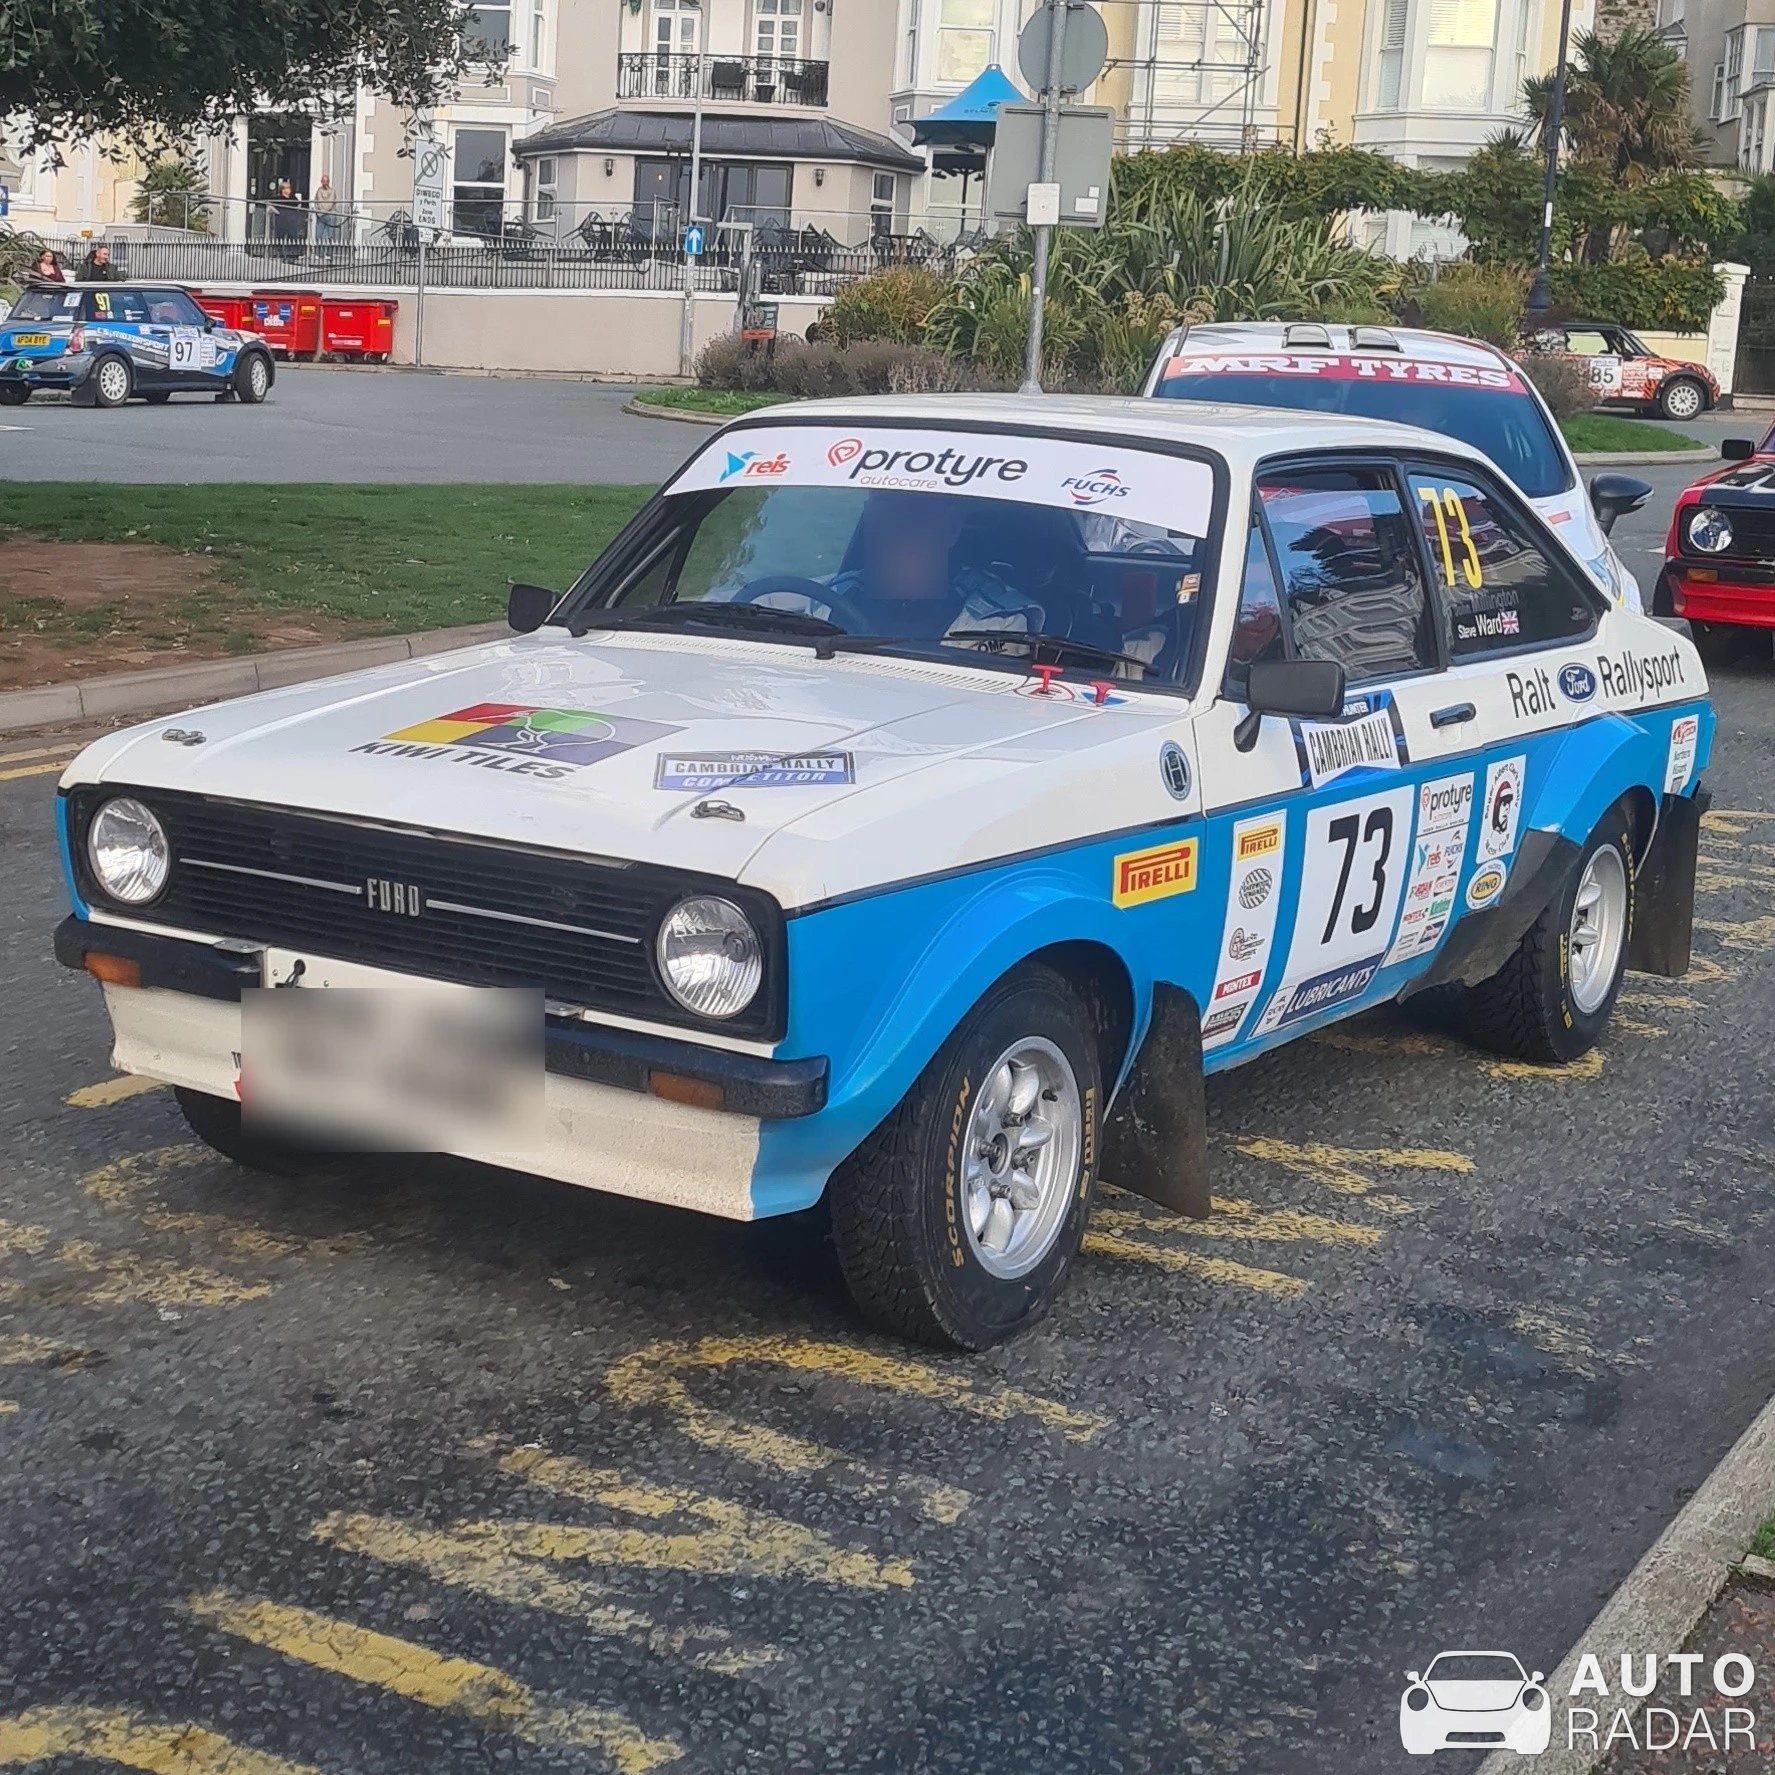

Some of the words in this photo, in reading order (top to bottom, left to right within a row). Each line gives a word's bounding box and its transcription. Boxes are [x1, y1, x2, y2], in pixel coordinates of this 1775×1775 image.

[95, 292, 111, 311] 97
[175, 341, 194, 362] 97
[1180, 356, 1340, 374] MRF
[1350, 358, 1511, 388] TYRES
[1591, 366, 1614, 384] 85
[746, 453, 791, 474] reis
[849, 446, 1028, 486] protyre
[859, 475, 938, 490] autocare
[1061, 477, 1132, 499] FUCHS
[1418, 487, 1484, 589] 73
[1475, 611, 1503, 637] Ward
[1505, 667, 1557, 718] Ralt
[1565, 668, 1590, 697] Ford
[1597, 645, 1685, 702] Rallysport
[349, 741, 457, 760] KIWI
[452, 750, 577, 779] TILES
[1308, 725, 1365, 776] CAMBRIAN
[1361, 717, 1393, 762] RALLY
[675, 762, 773, 774] CAMBRIAN
[782, 759, 836, 770] RALLY
[682, 772, 827, 788] COMPETITOR
[1429, 783, 1472, 821] protyre
[1240, 828, 1279, 855] PIRELLI
[1120, 847, 1191, 894] PIRELLI
[1320, 807, 1393, 945] 73
[366, 878, 420, 917] FORD
[1475, 877, 1499, 894] RING
[1222, 974, 1257, 996] MINTEX
[1287, 965, 1376, 1012] LUBRICANTS
[945, 1074, 970, 1267] SCORPION
